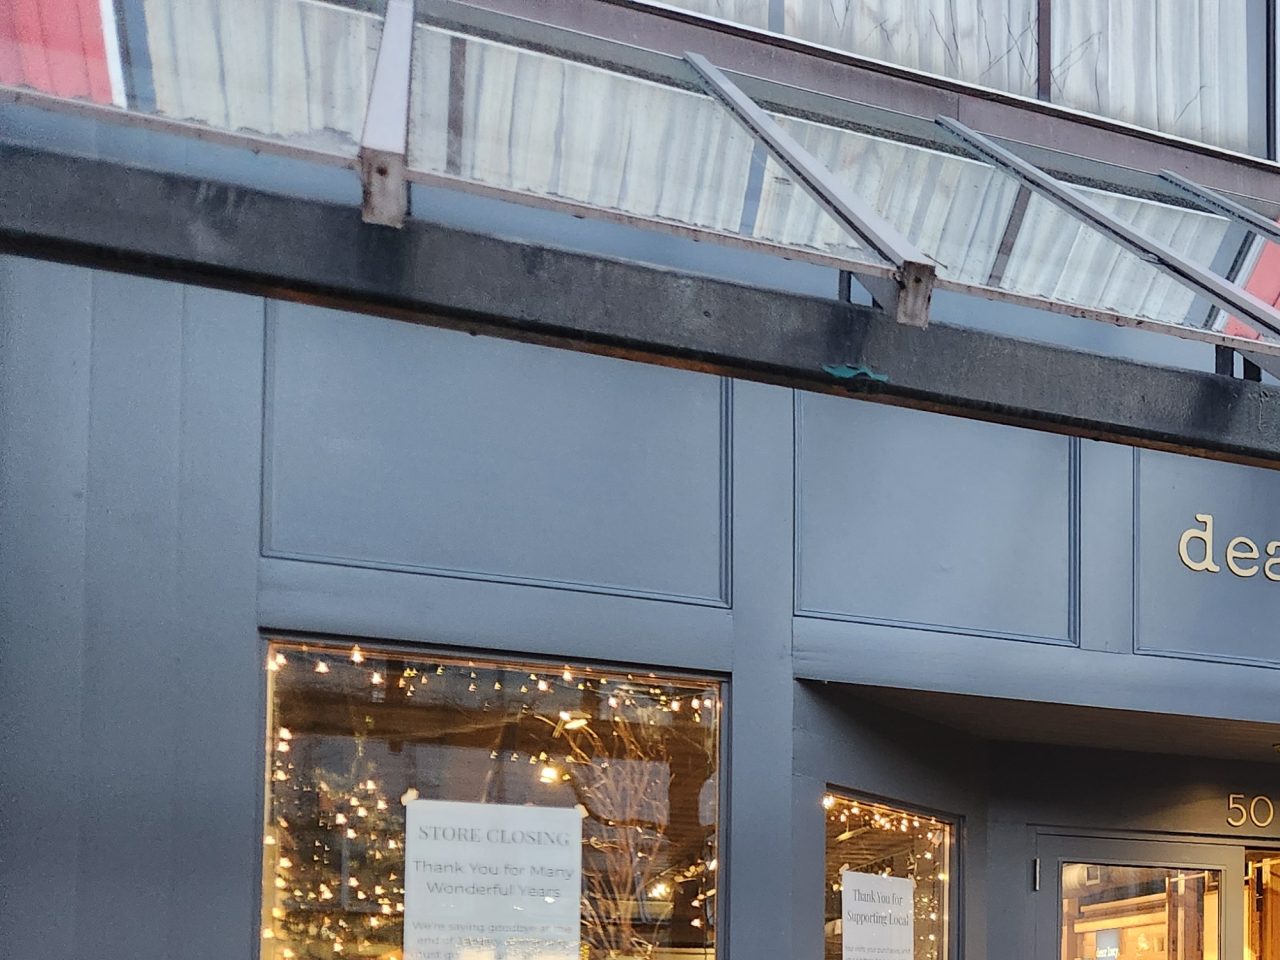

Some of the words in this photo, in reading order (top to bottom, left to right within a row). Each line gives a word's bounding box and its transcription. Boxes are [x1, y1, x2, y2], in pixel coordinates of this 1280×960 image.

[1226, 793, 1275, 829] 50
[418, 826, 481, 843] STORE
[486, 829, 570, 847] CLOSING
[413, 860, 464, 874] Thank
[469, 863, 498, 875] You
[504, 864, 526, 876] for
[530, 865, 574, 881] Many
[426, 881, 513, 896] Wonderful
[517, 884, 561, 898] Years
[852, 889, 876, 903] Thank
[876, 891, 891, 905] You
[892, 892, 904, 905] for
[847, 910, 887, 927] Supporting
[888, 913, 909, 926] Local
